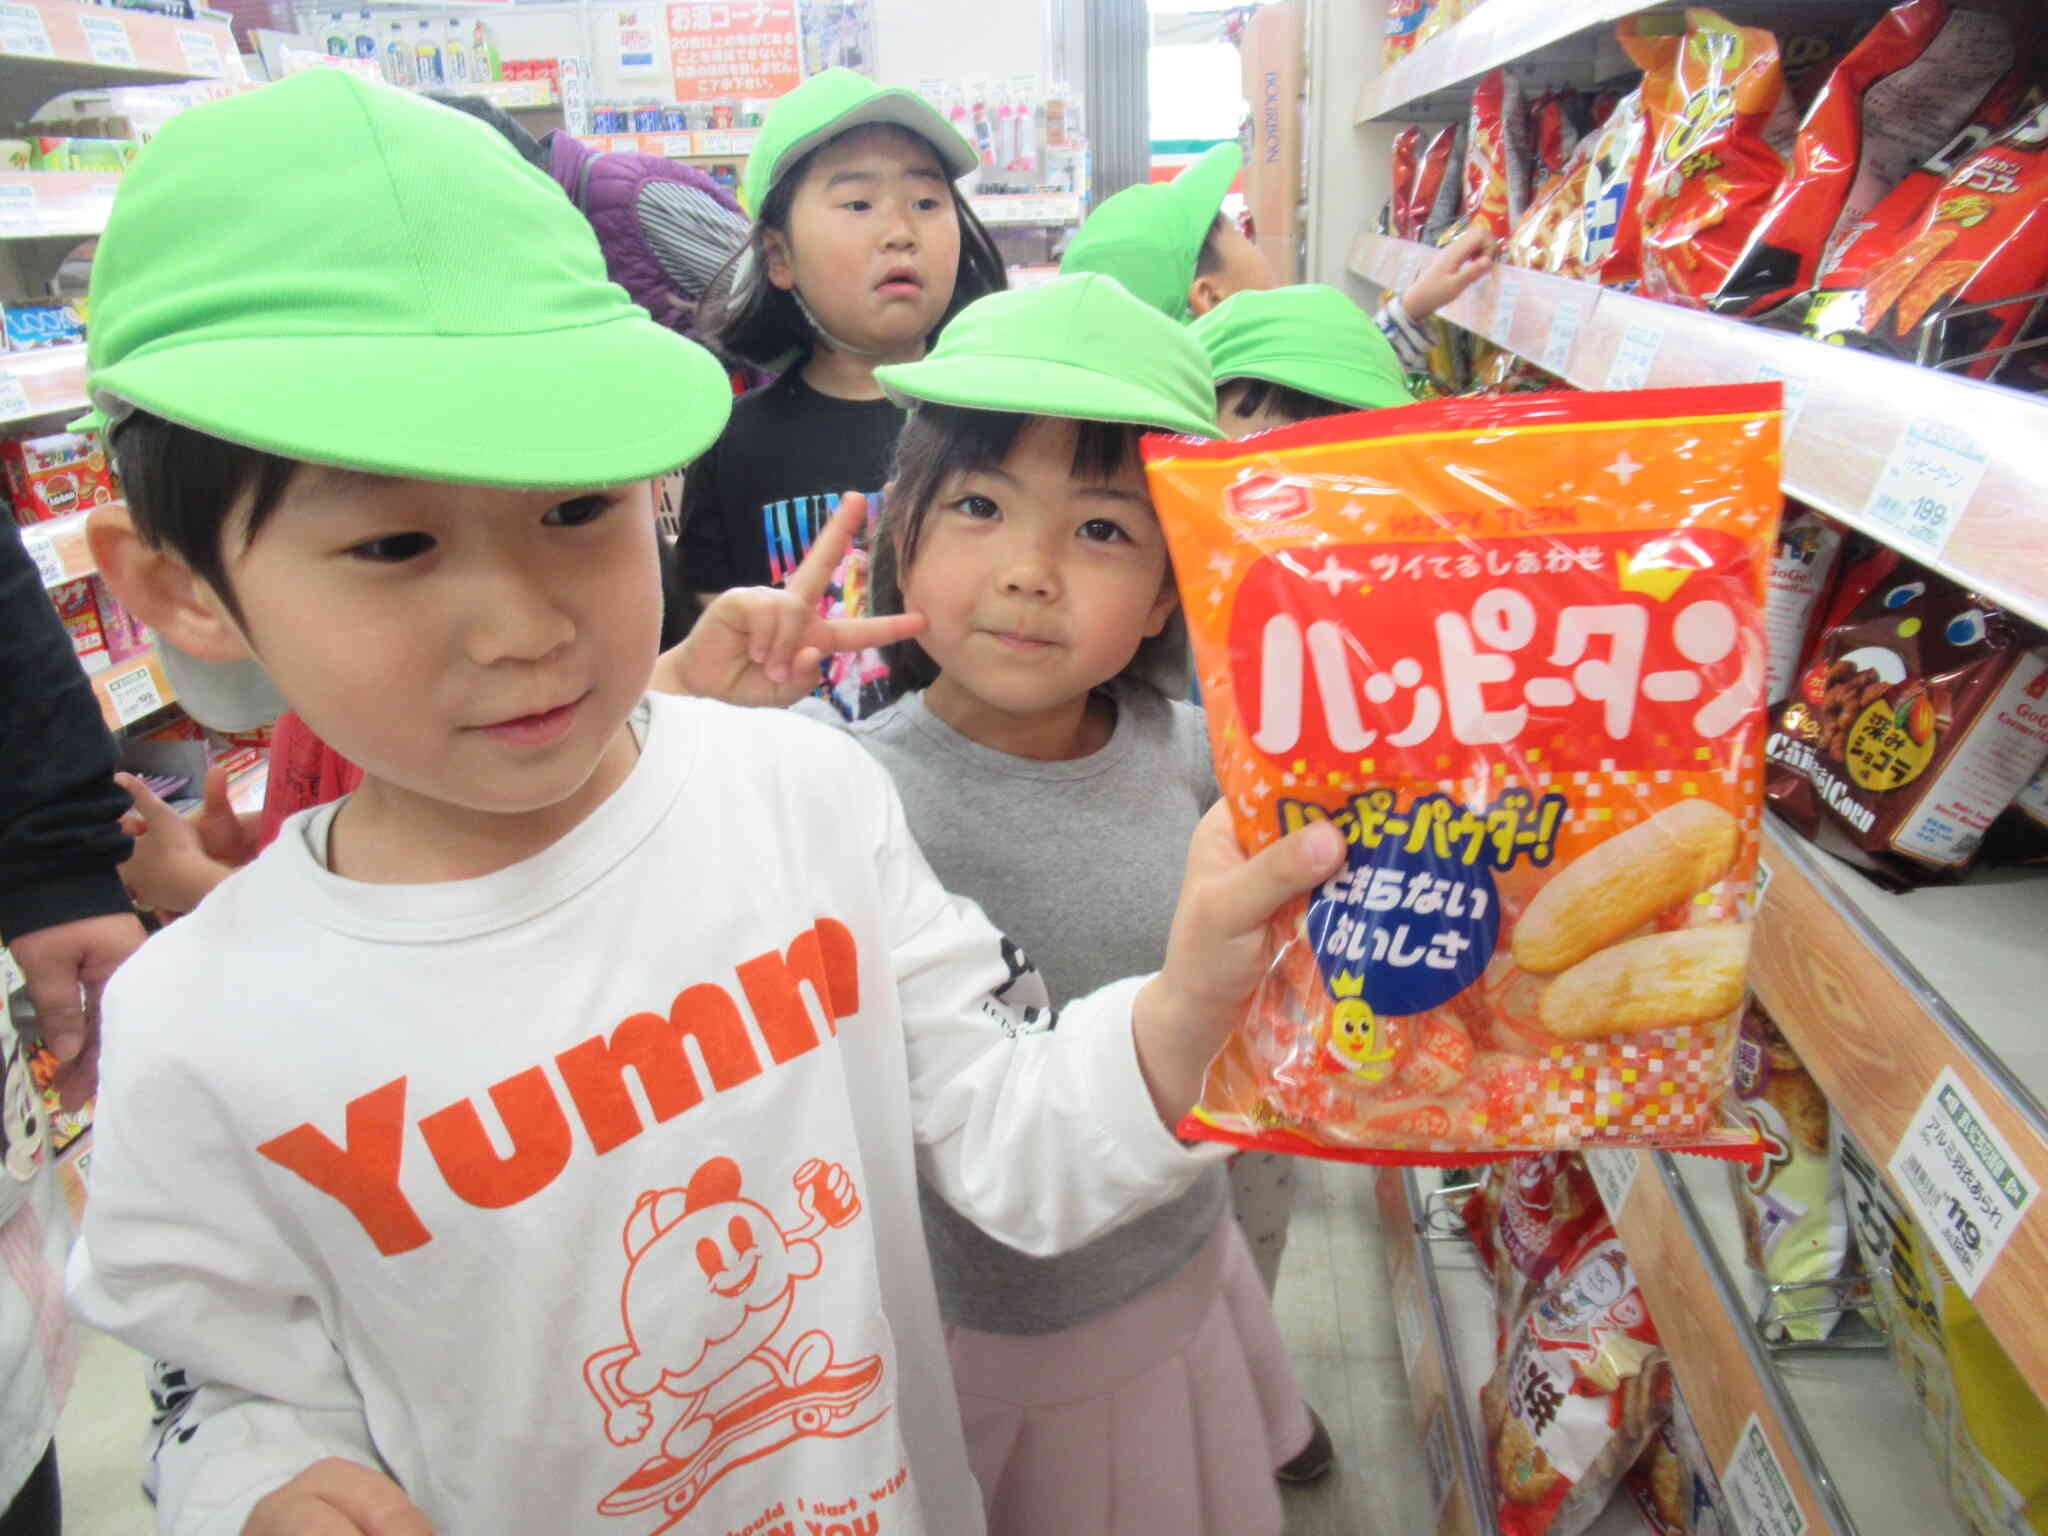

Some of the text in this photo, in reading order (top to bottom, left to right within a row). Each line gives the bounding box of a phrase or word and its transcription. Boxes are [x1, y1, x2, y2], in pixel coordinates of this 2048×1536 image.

[1369, 546, 1606, 582] ツイてるしあわせ
[1252, 586, 1765, 755] ハッピーターン
[1326, 911, 1471, 970] おいしさ
